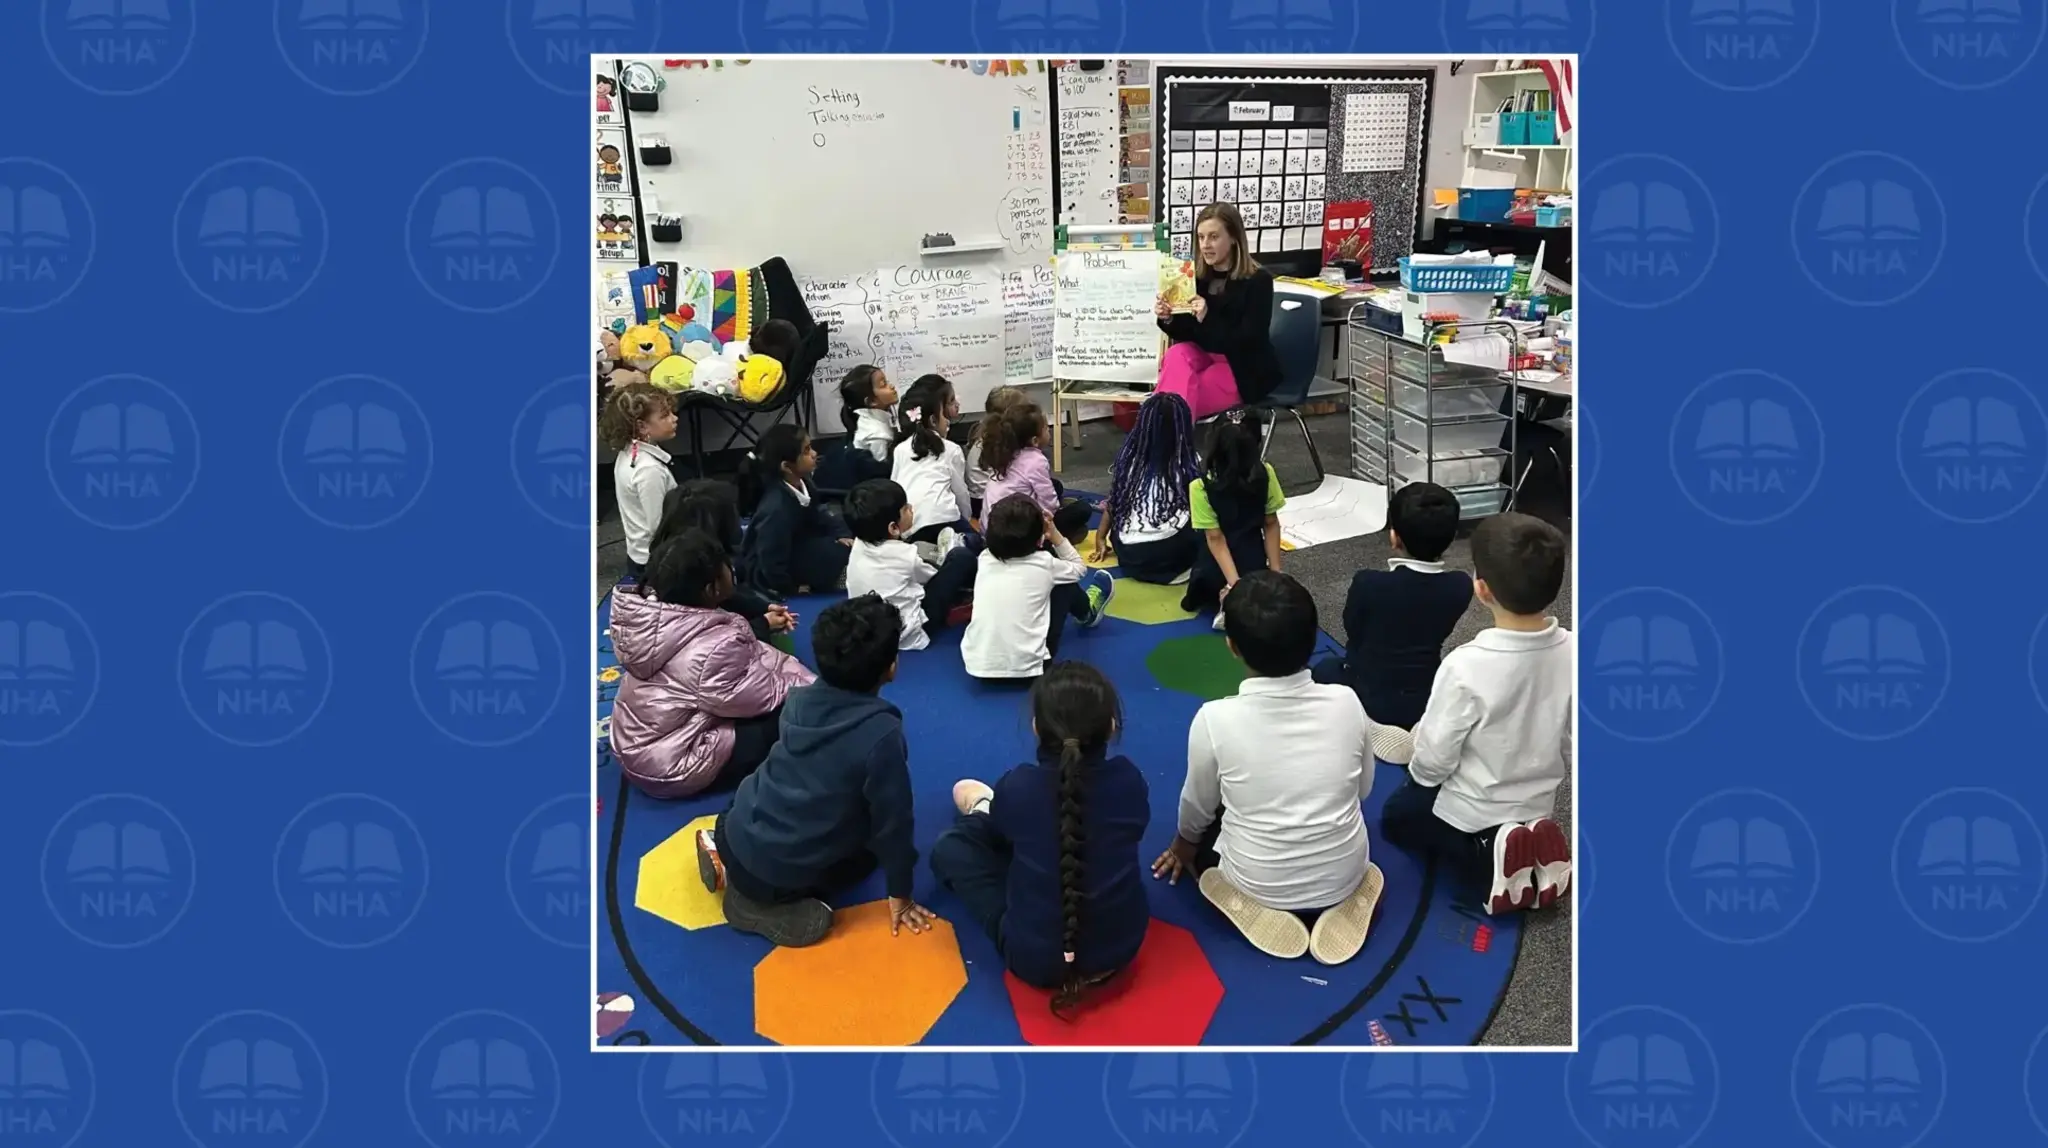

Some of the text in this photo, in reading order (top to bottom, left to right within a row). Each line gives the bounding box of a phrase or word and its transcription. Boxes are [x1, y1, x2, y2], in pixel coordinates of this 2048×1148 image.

[808, 85, 861, 108] Setting
[807, 109, 852, 127] Talking
[1239, 106, 1266, 116] February
[603, 199, 615, 214] 3
[1083, 252, 1126, 268] Problem
[894, 265, 973, 286] Courage
[1057, 275, 1079, 288] What
[805, 279, 848, 293] Character
[921, 292, 930, 300] be
[1071, 345, 1087, 354] Good
